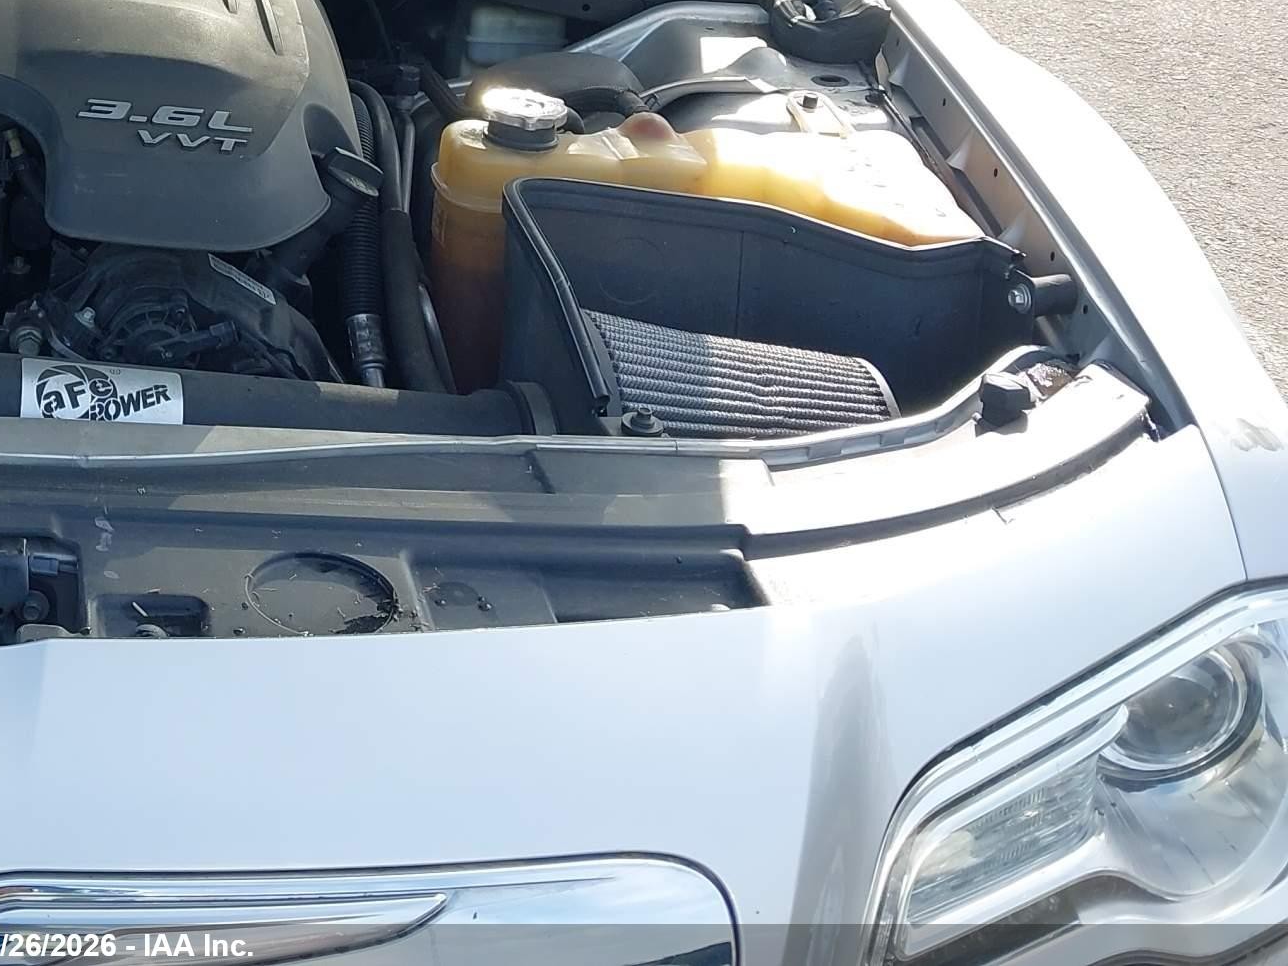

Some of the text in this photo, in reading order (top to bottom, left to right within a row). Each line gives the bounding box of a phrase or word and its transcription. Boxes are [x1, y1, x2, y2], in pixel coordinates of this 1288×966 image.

[77, 98, 254, 133] 3.6L
[137, 129, 248, 152] VVT
[89, 384, 172, 422] POWER
